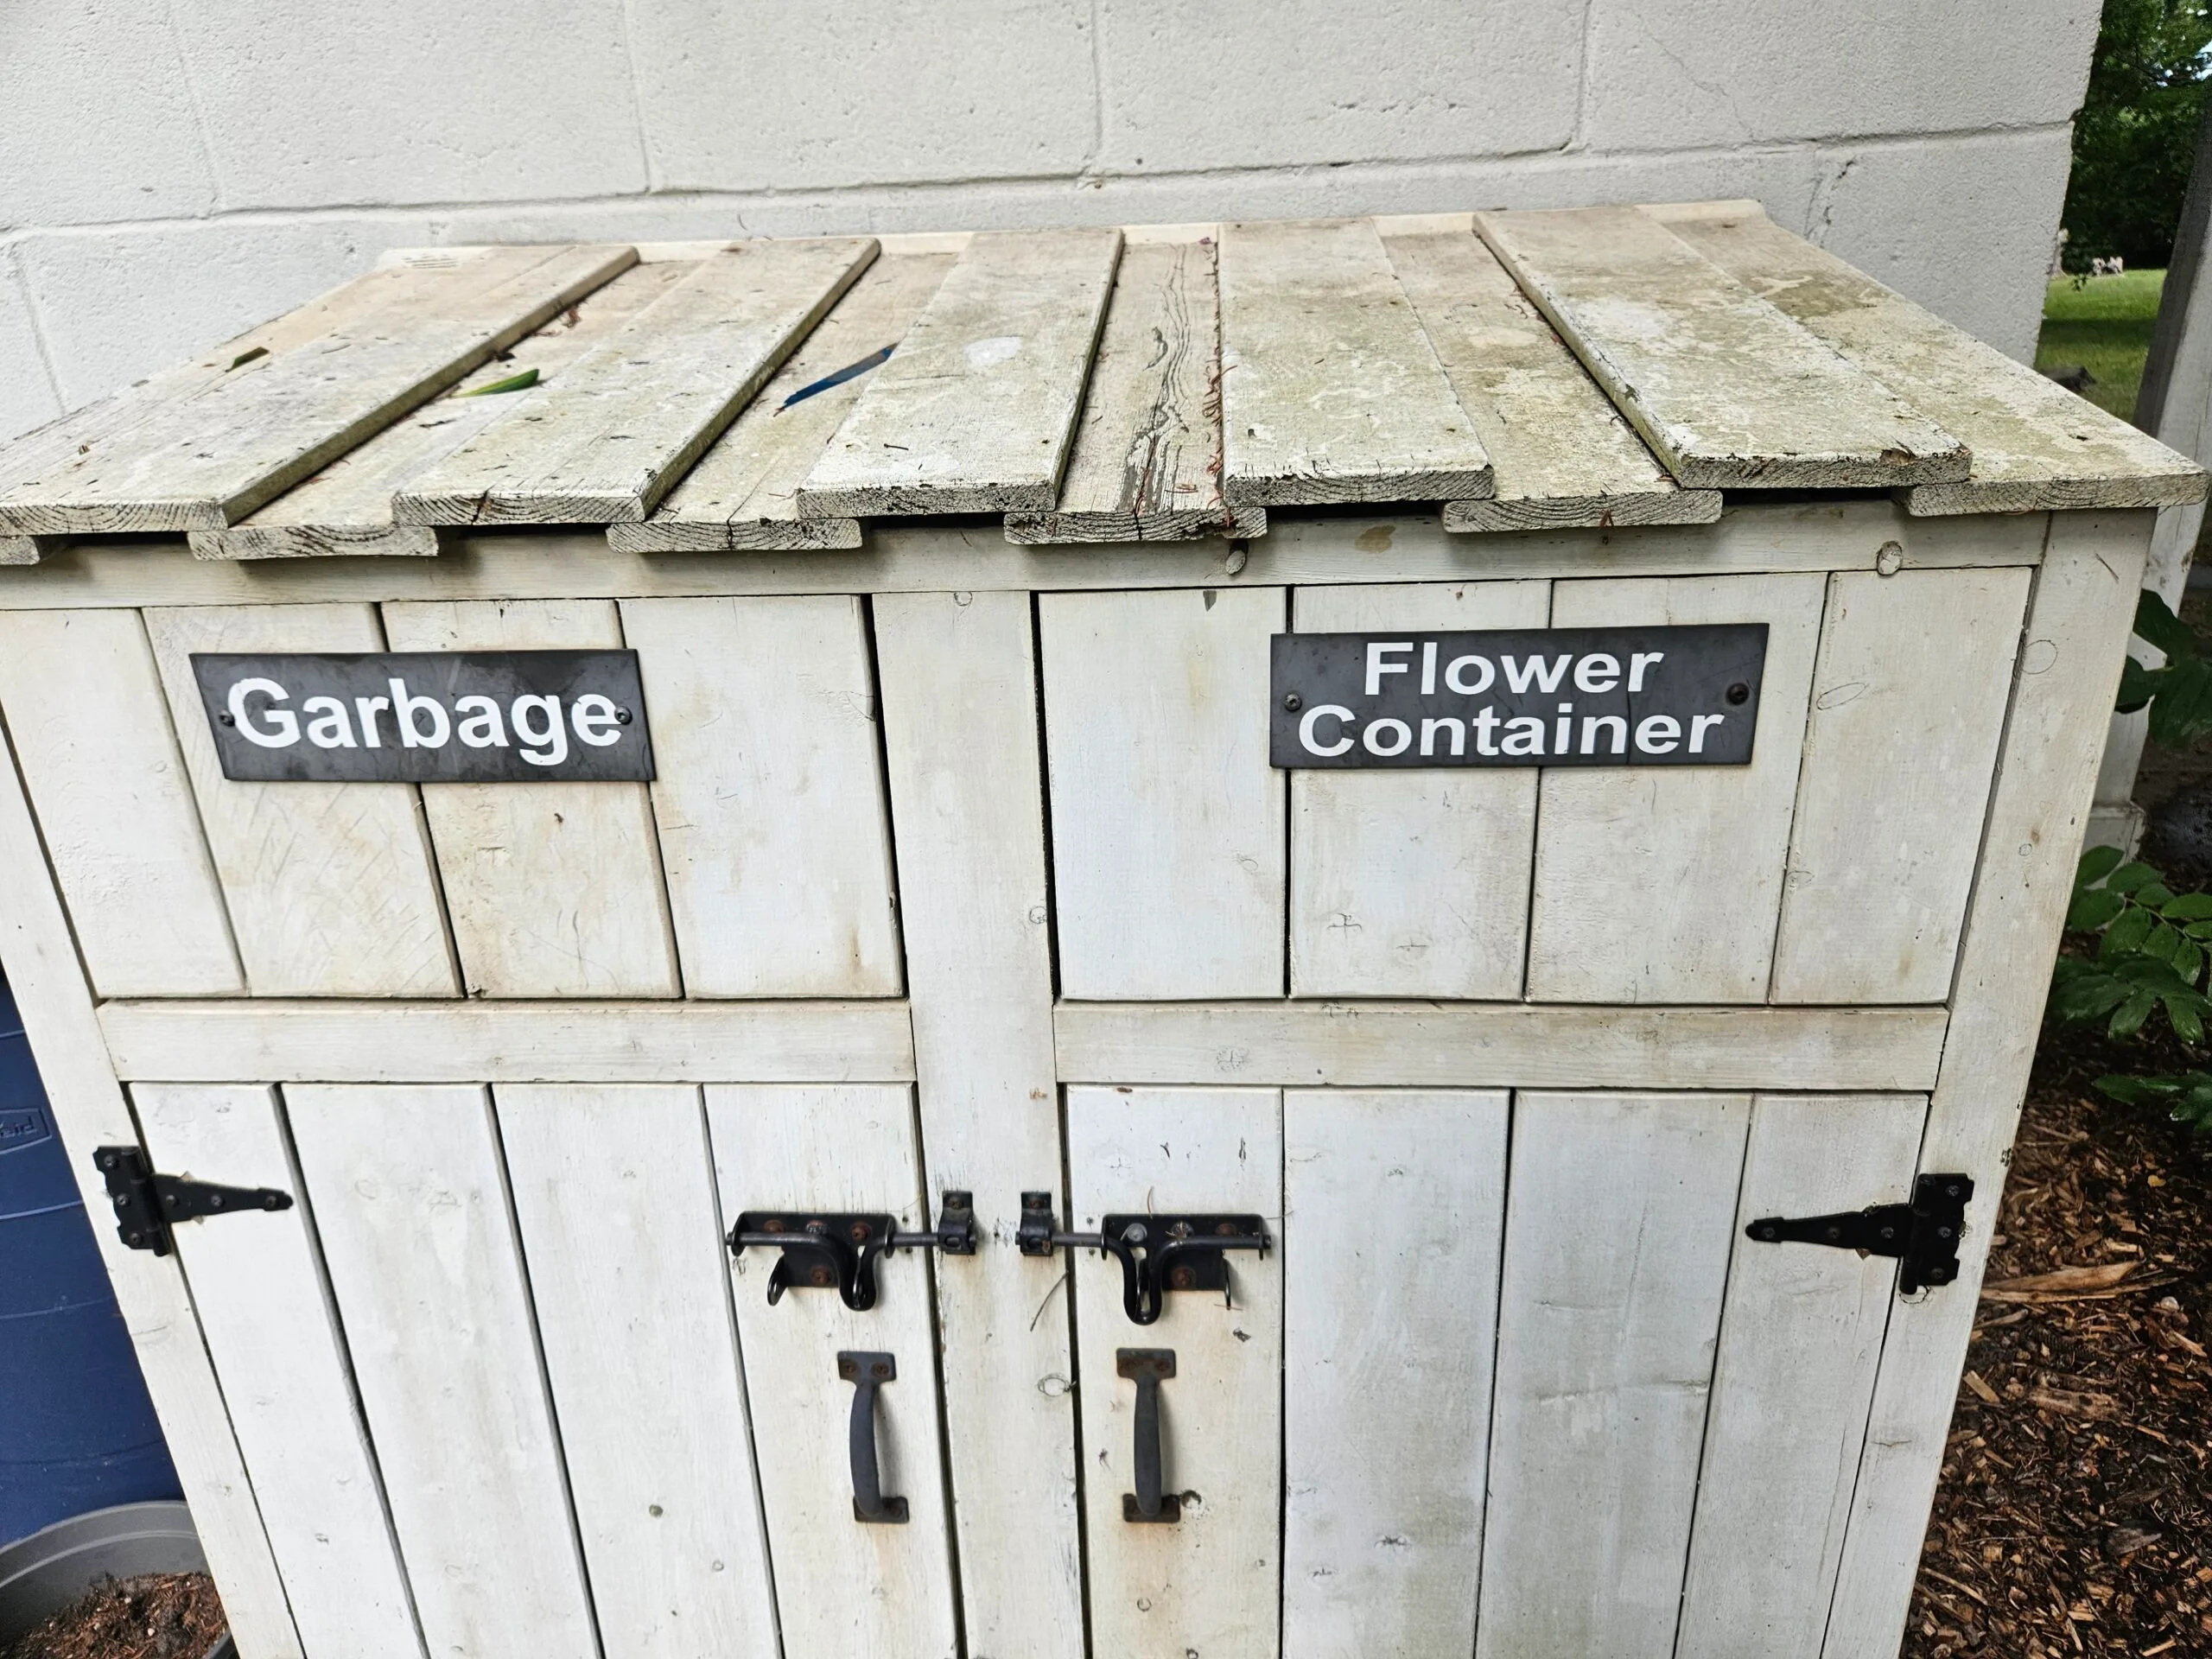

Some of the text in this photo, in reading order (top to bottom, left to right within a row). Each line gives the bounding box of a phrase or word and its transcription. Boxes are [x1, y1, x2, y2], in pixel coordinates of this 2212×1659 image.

[1364, 641, 1664, 696] Flower
[227, 677, 622, 766] Garbage
[1298, 702, 1725, 757] Container
